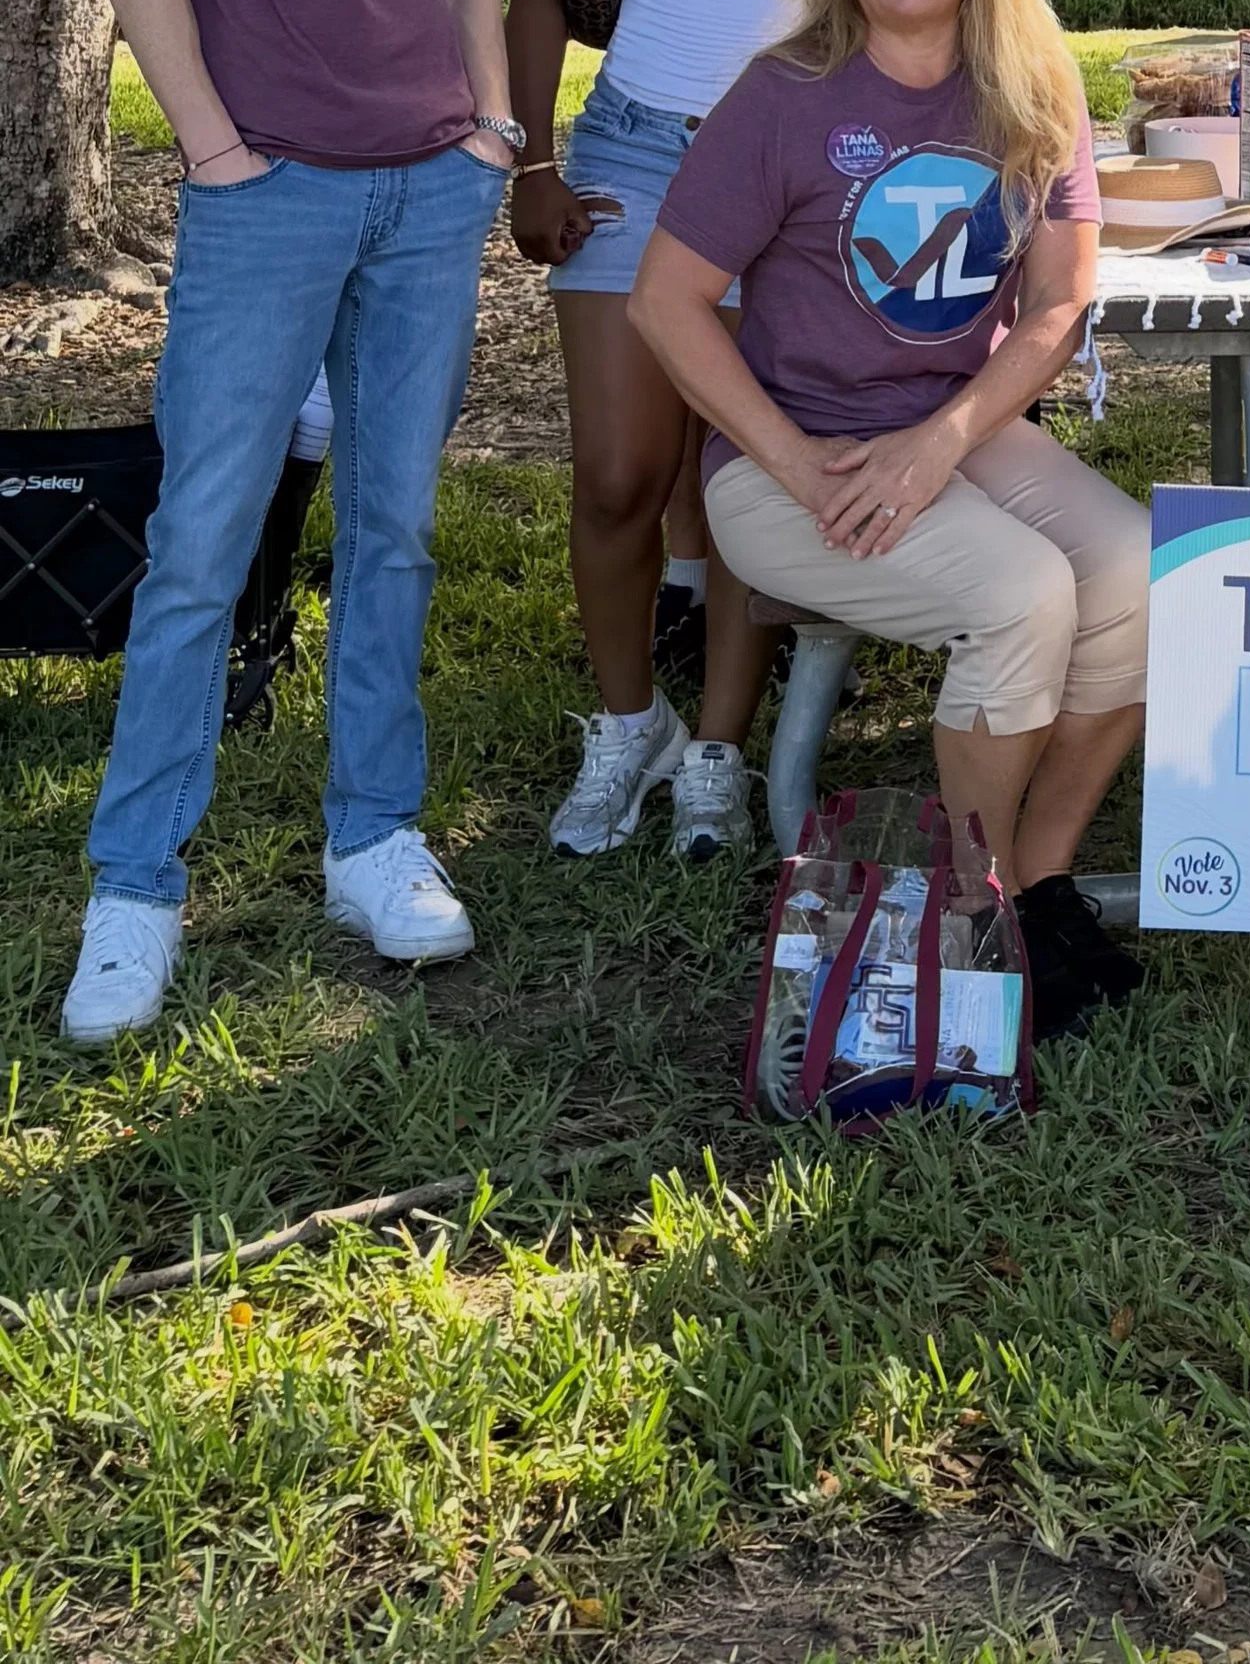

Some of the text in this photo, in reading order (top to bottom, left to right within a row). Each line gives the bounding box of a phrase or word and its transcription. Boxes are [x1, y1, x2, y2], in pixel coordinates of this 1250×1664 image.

[840, 133, 878, 146] TANA
[836, 144, 885, 158] LLINAS
[1174, 851, 1225, 878] Vote
[1165, 873, 1233, 896] Nov. 3
